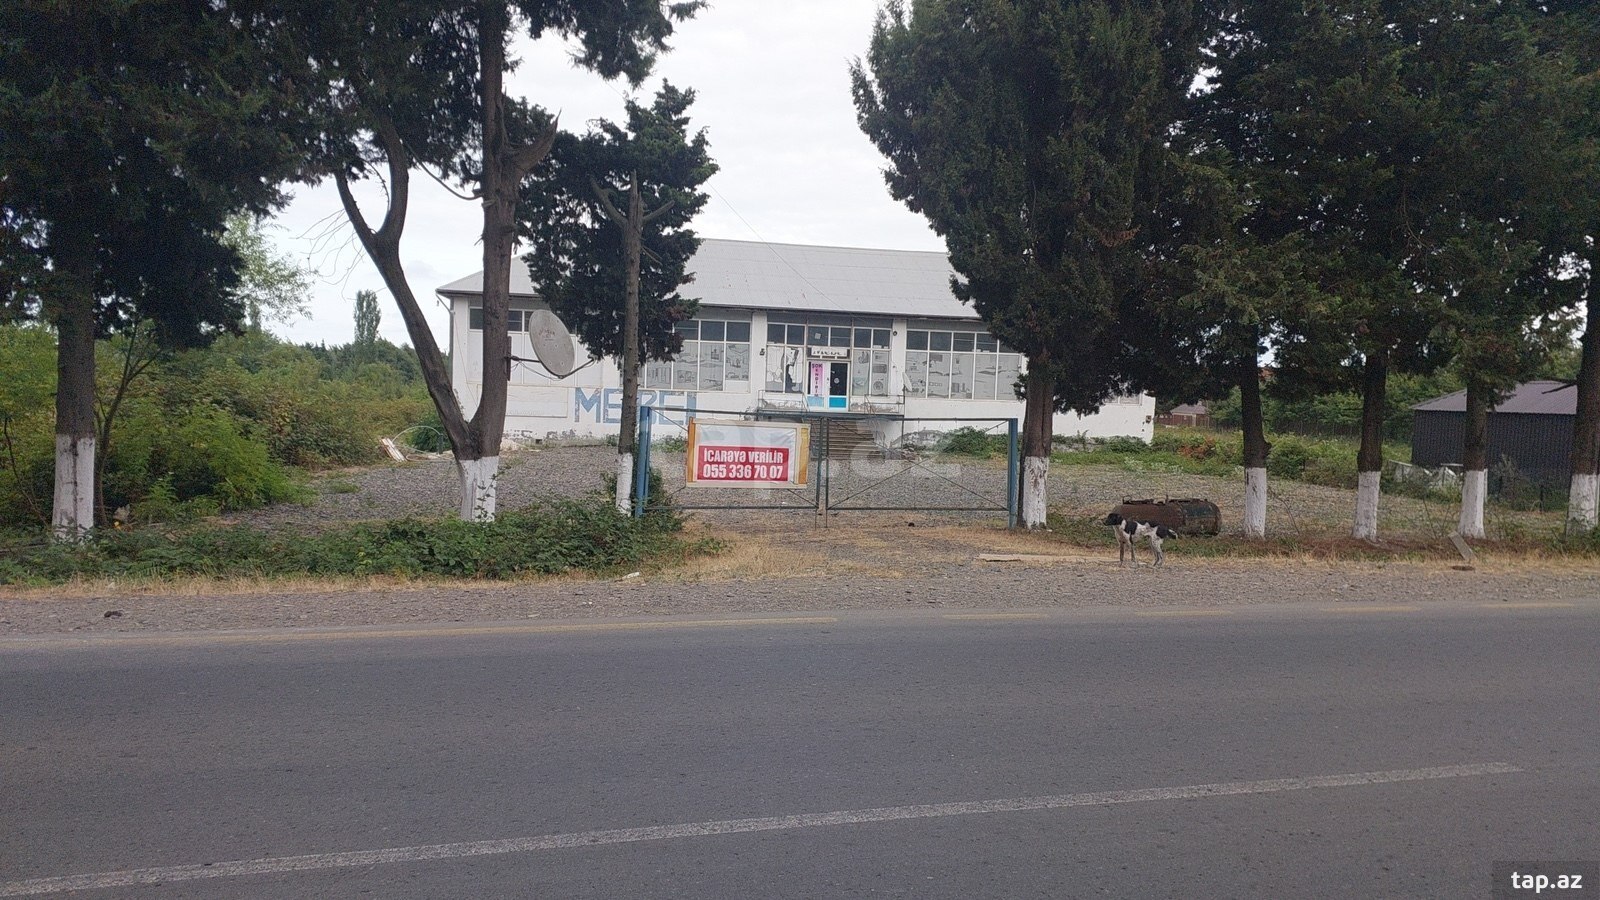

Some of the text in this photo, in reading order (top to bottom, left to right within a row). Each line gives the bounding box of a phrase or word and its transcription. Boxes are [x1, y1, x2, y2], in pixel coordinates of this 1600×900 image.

[748, 449, 784, 464] VERİLİR
[702, 464, 784, 479] 055 336 70 07
